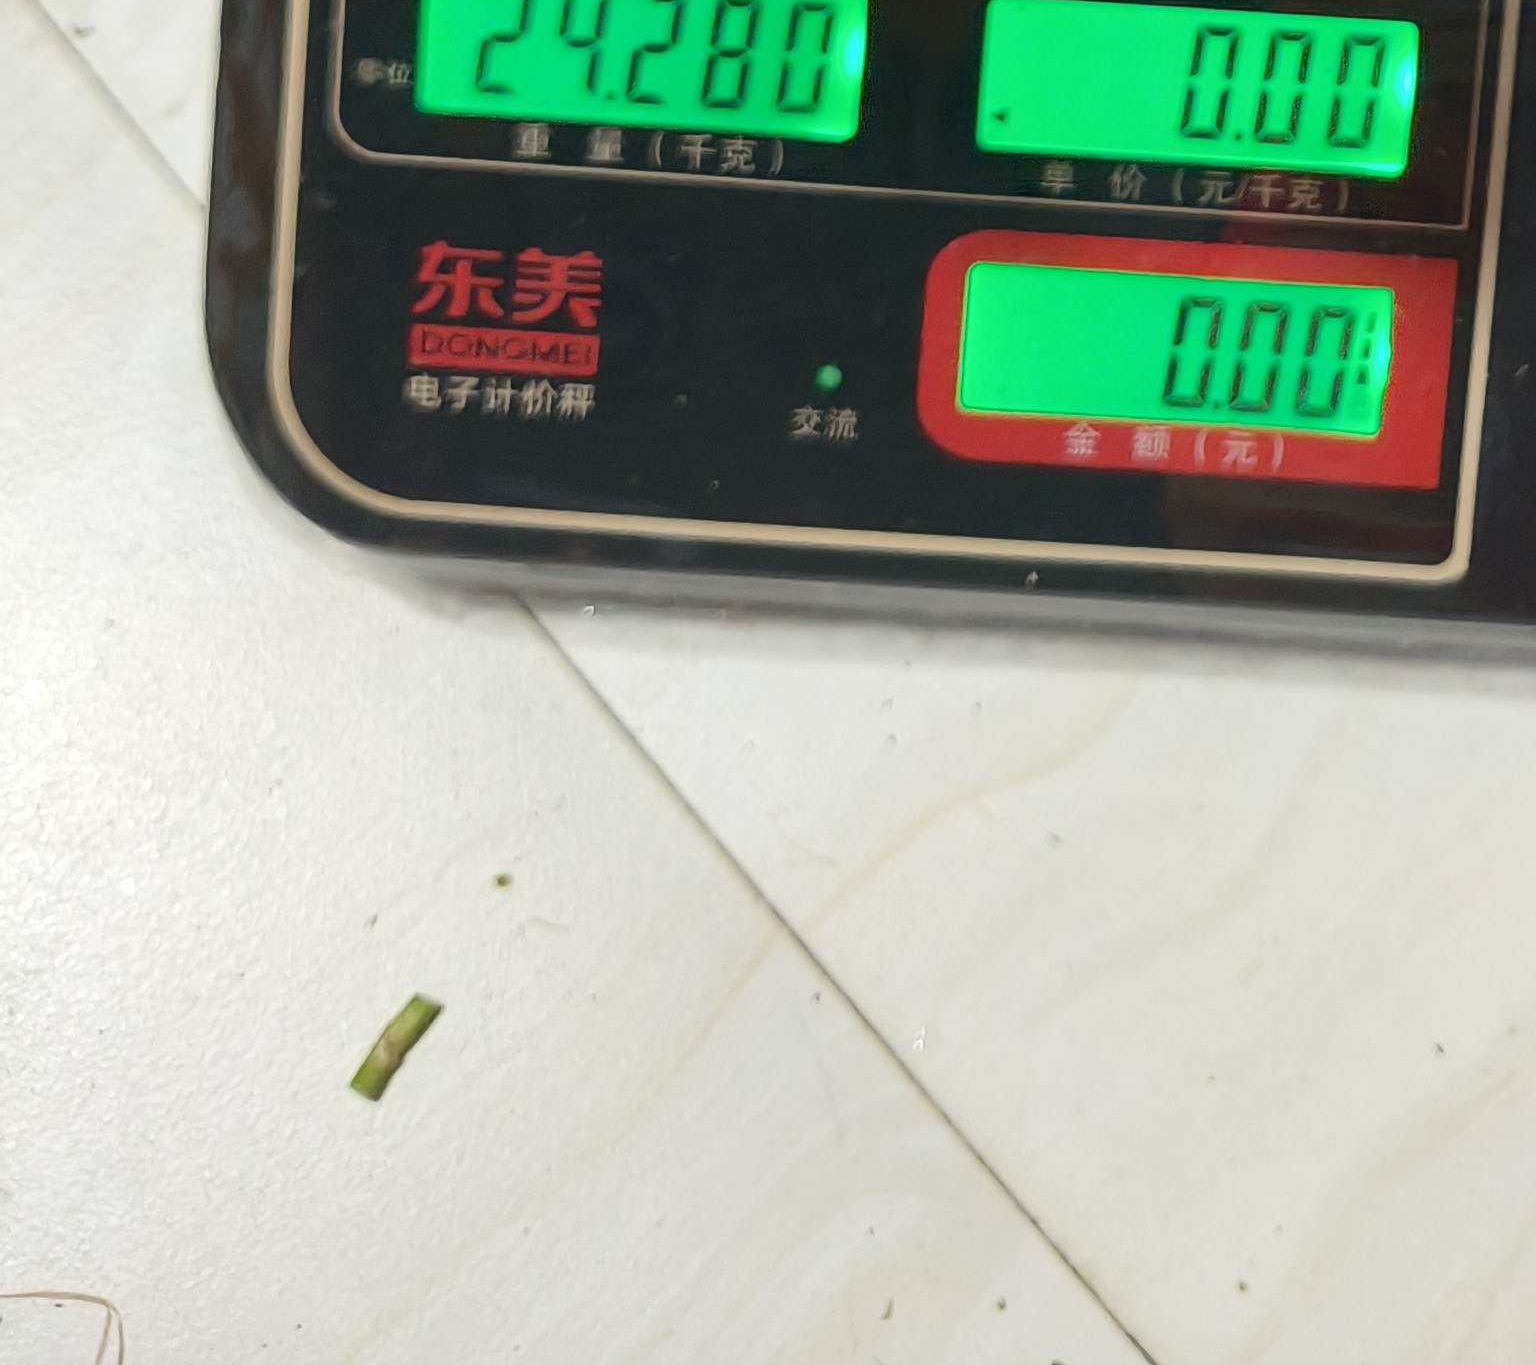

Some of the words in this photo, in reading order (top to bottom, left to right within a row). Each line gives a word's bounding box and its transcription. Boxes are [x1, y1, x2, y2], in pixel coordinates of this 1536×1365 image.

[1180, 25, 1387, 147] 0.00
[411, 239, 603, 327] 东美
[419, 328, 595, 366] DONGMEI
[1162, 296, 1355, 417] 0.00
[404, 374, 596, 420] 电子计价秤
